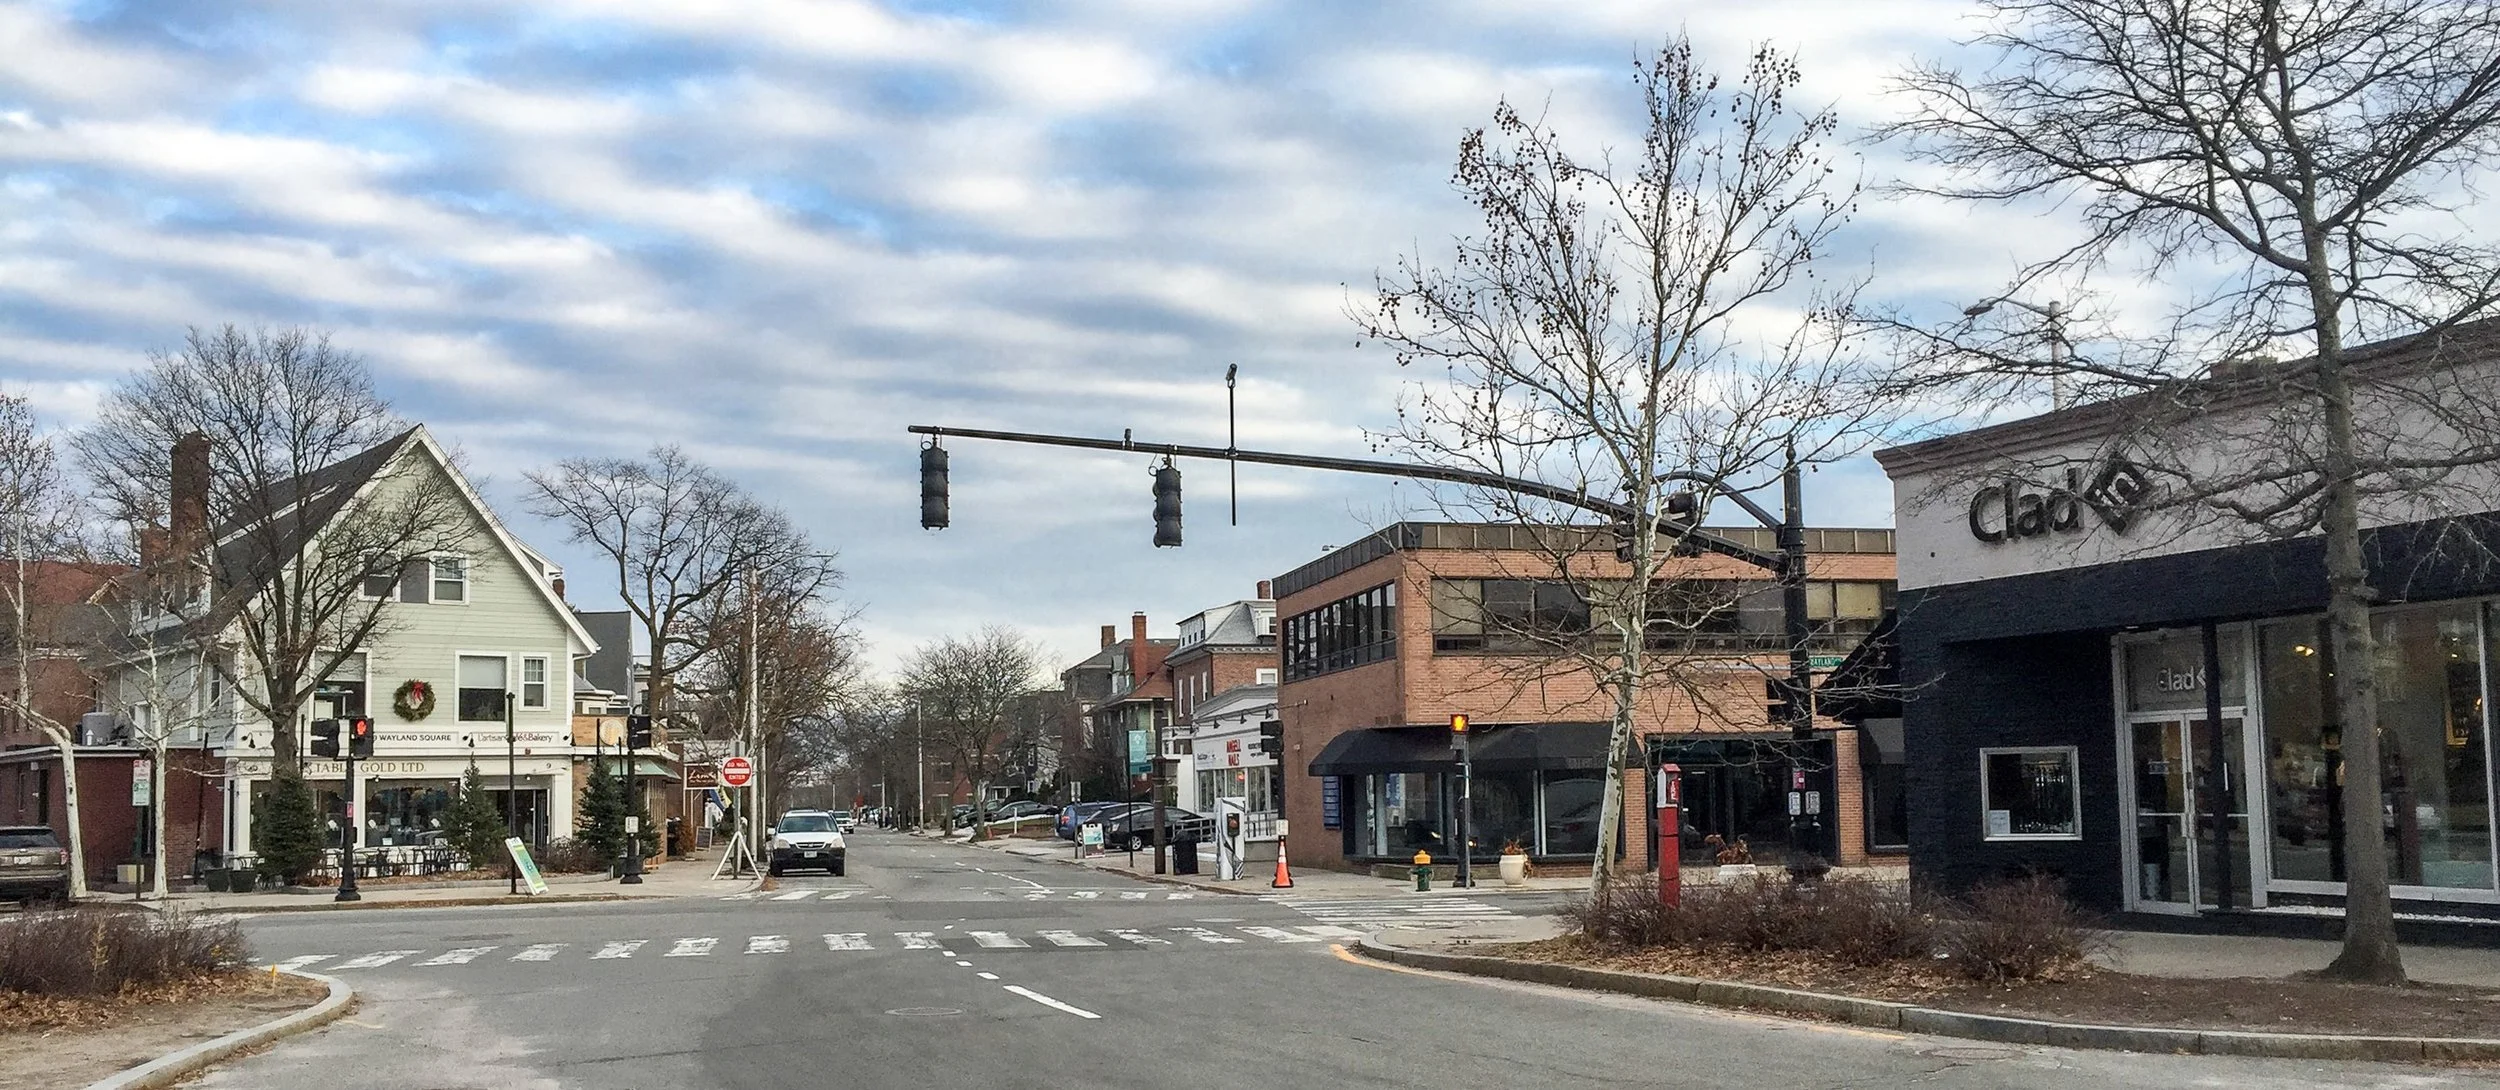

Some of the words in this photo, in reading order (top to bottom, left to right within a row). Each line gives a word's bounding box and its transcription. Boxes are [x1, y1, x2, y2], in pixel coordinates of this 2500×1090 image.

[1969, 468, 2084, 542] Clad
[2156, 665, 2195, 691] Clad
[360, 762, 397, 773] GOLD
